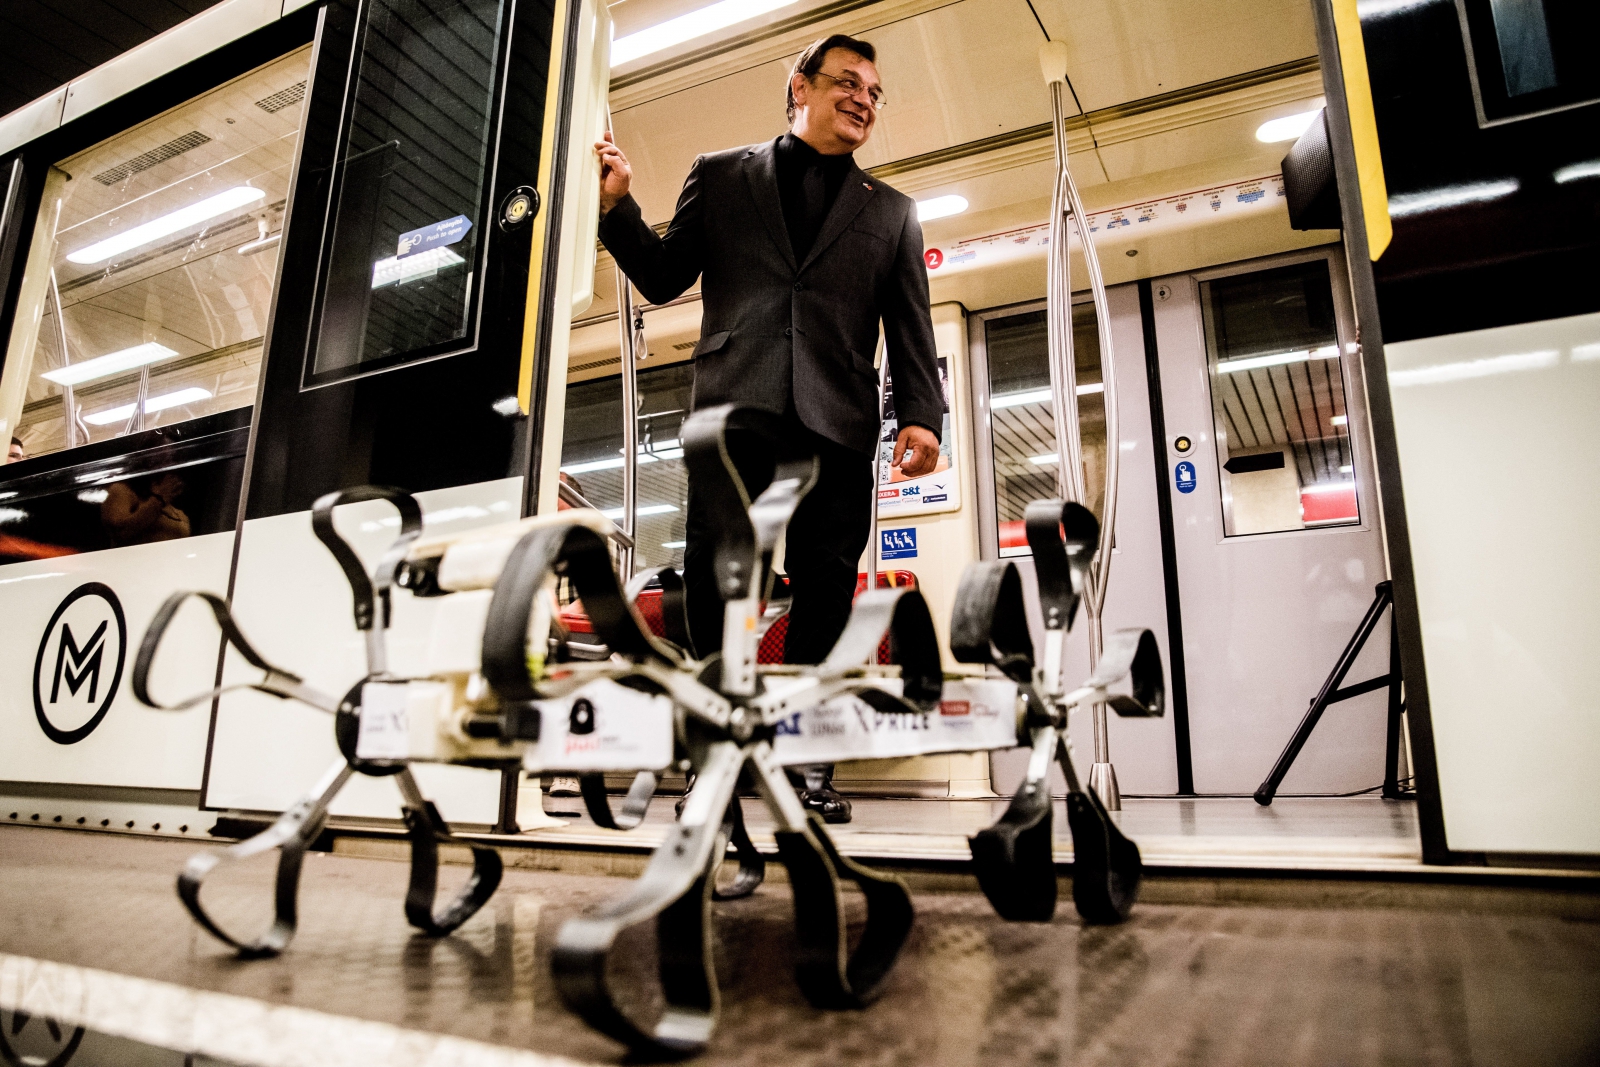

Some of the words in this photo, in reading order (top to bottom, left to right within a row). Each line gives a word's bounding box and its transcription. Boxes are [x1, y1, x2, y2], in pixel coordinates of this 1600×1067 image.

[426, 234, 439, 242] Push
[448, 227, 462, 235] open
[928, 252, 939, 266] 2
